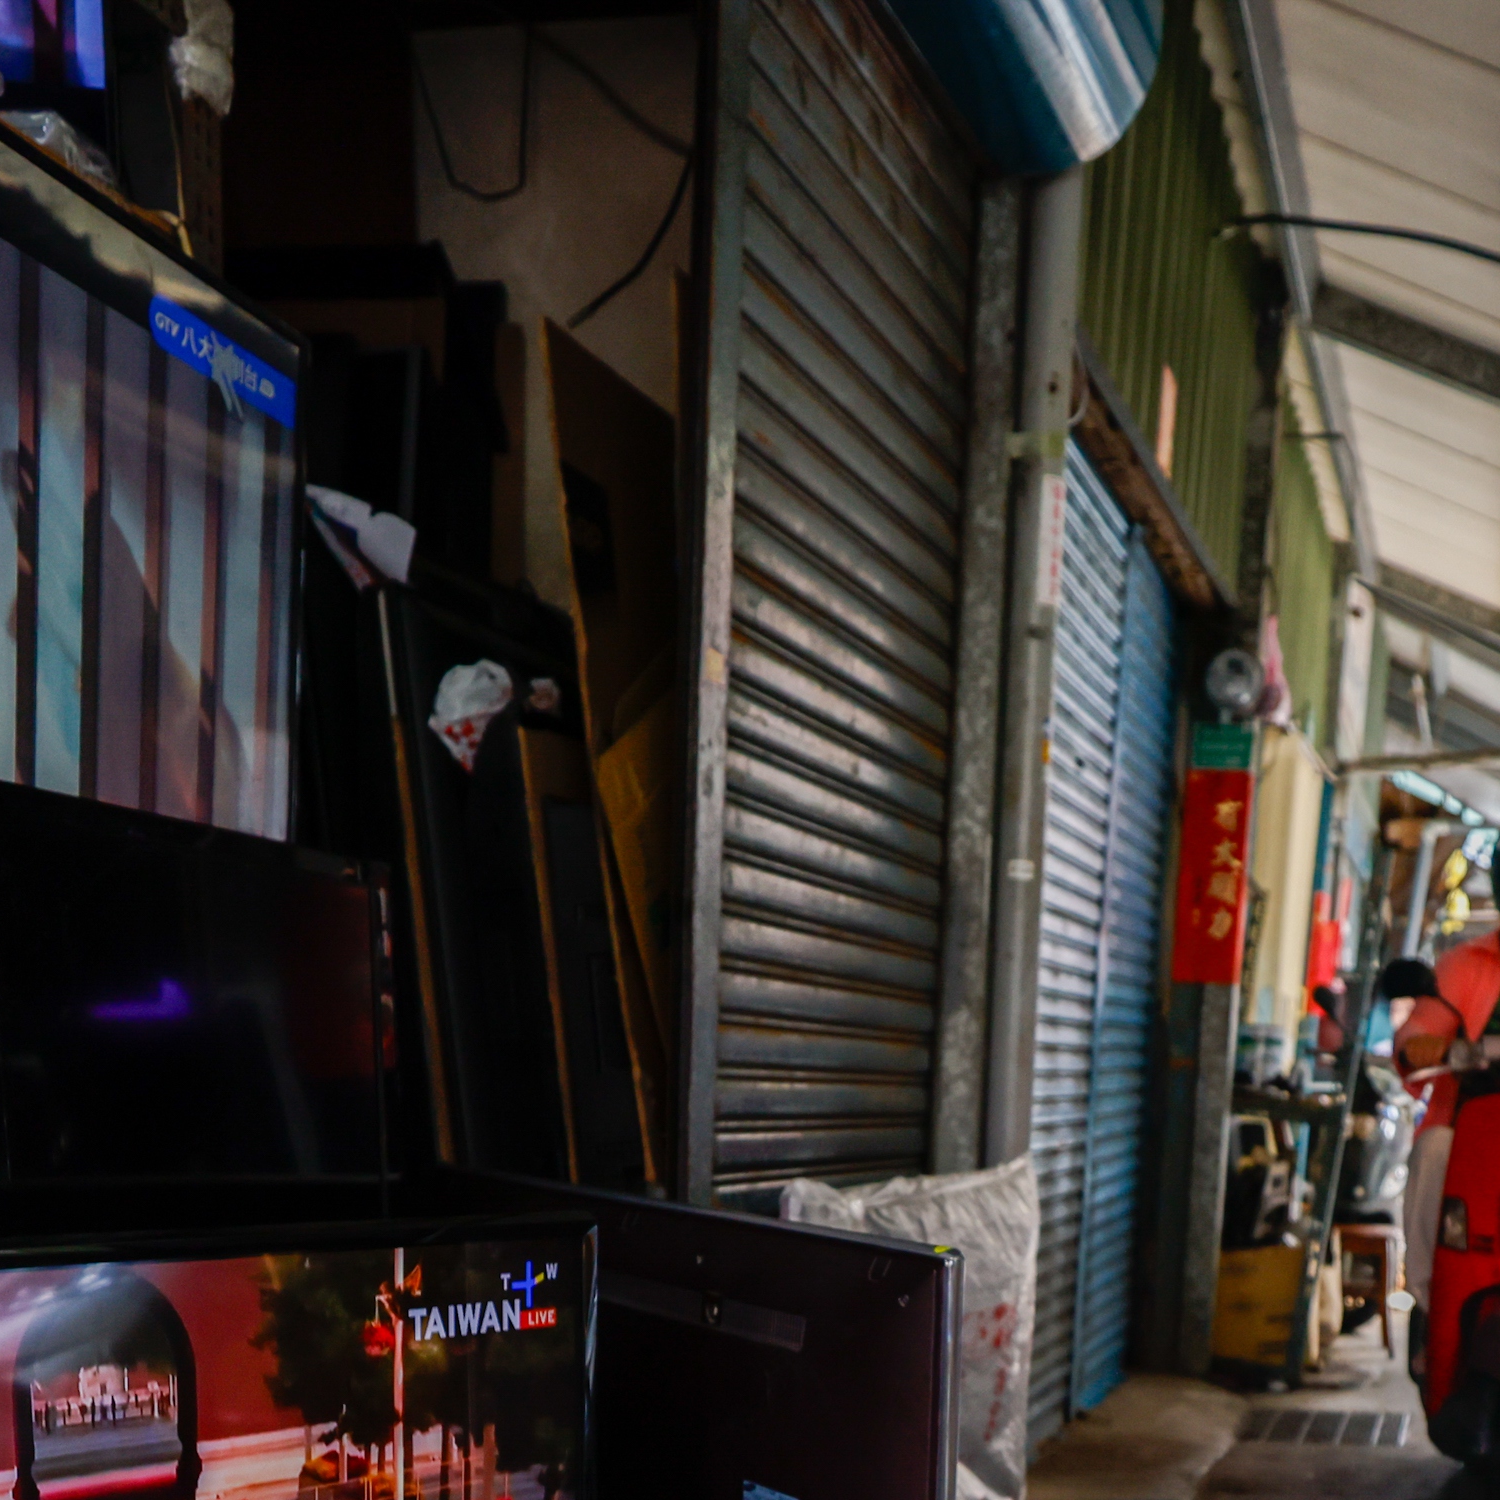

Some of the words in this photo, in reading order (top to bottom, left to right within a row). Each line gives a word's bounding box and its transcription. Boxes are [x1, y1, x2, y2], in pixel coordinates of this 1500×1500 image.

[155, 311, 181, 337] GTV
[182, 327, 258, 392] 八大台
[408, 1299, 520, 1341] TAIWAN
[528, 1309, 555, 1326] LIVE
